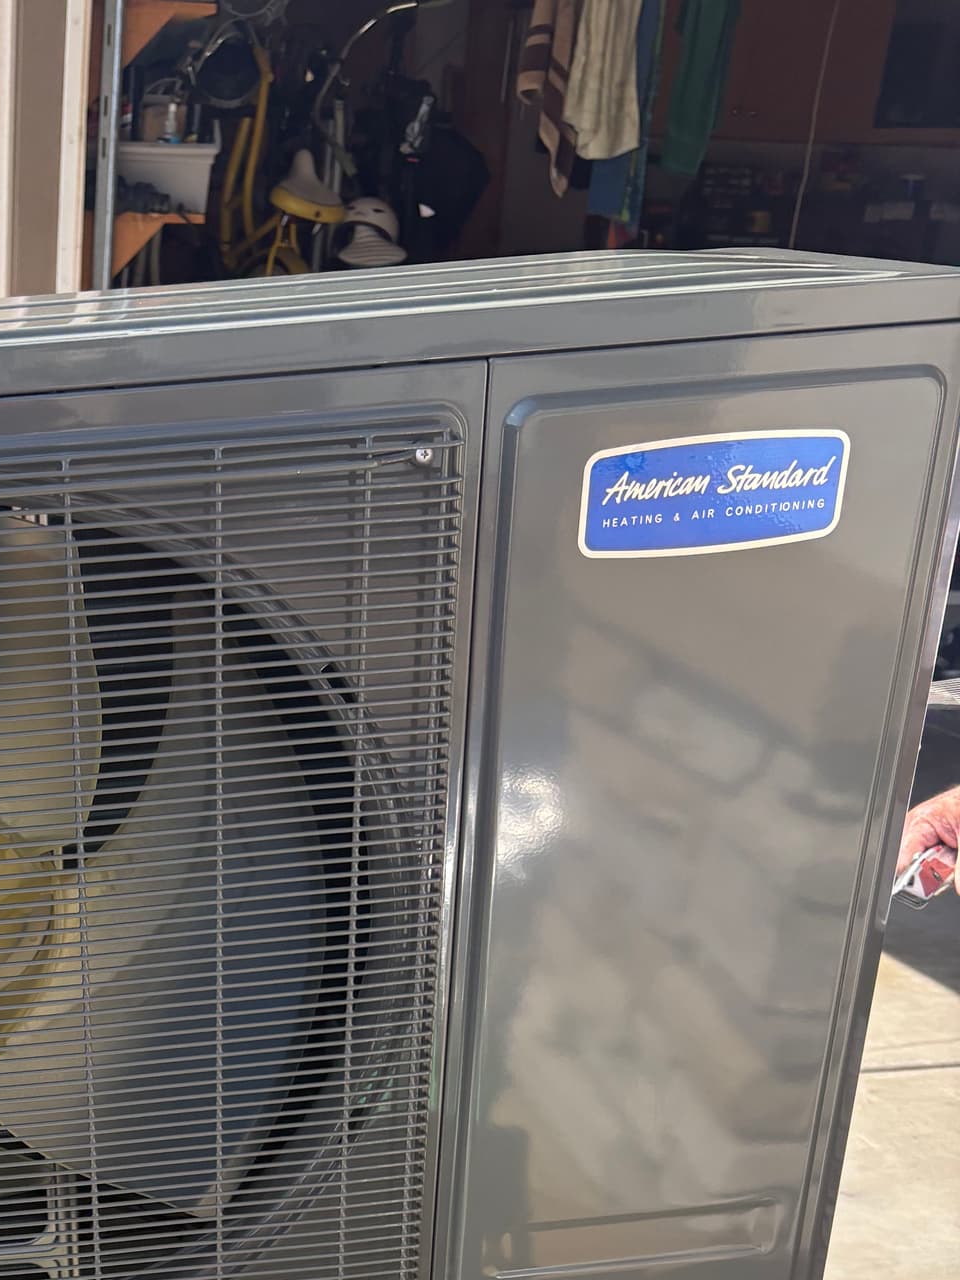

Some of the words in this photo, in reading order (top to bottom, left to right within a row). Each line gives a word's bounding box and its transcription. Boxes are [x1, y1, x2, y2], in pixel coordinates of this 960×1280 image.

[602, 471, 711, 505] American
[717, 455, 837, 495] Standard
[602, 513, 664, 528] HEATING
[673, 511, 681, 523] &
[691, 507, 716, 521] AIR
[725, 498, 826, 518] CONDITIONING
